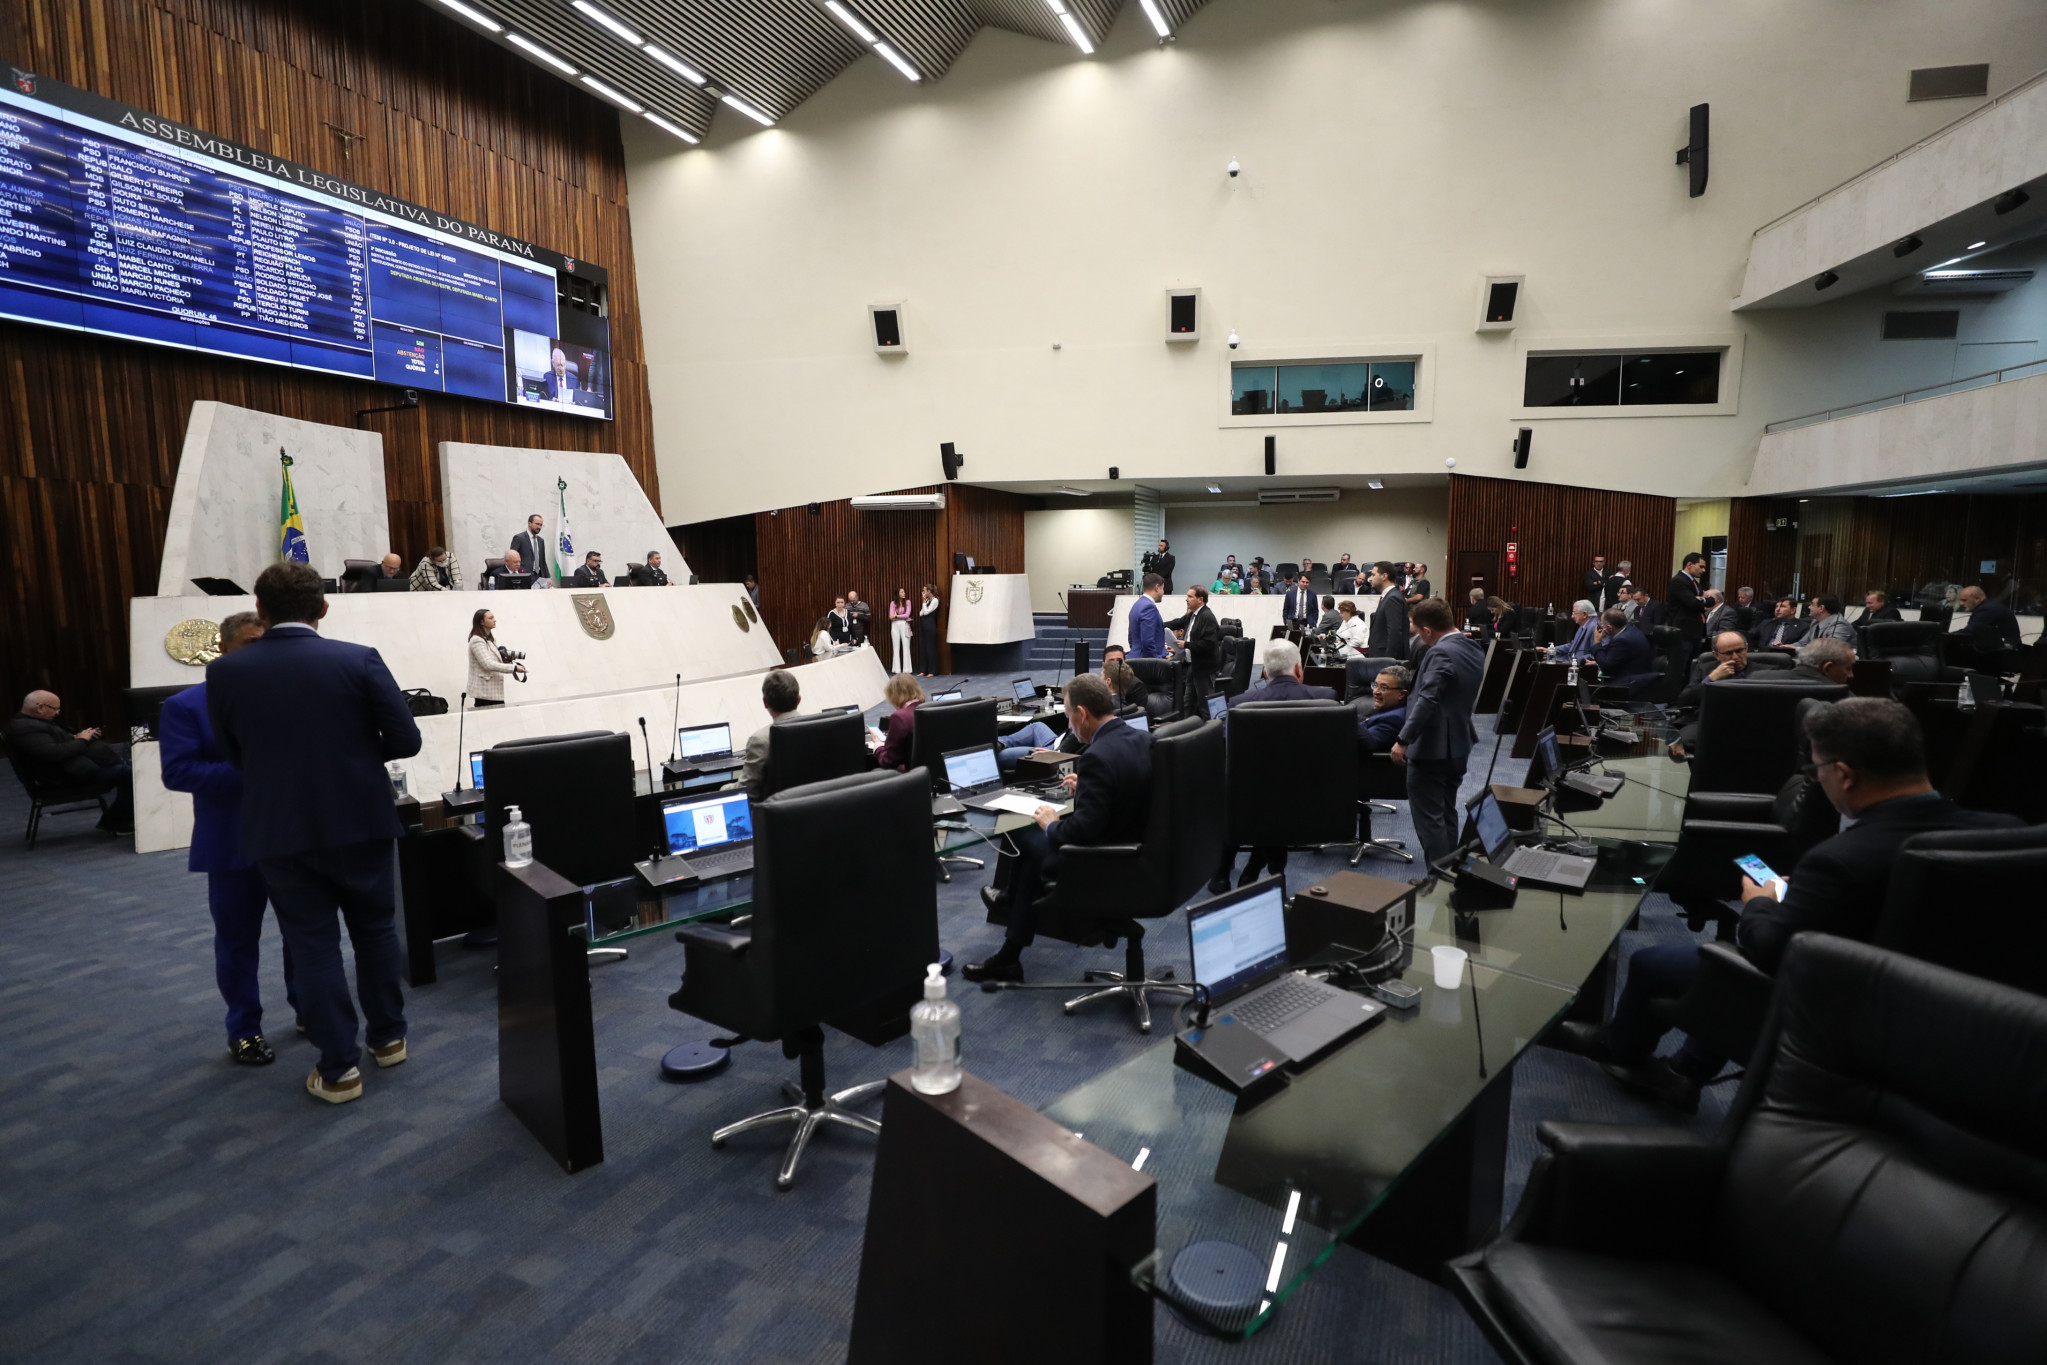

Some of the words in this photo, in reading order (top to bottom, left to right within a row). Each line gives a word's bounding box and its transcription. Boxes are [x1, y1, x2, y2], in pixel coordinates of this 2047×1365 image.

[82, 138, 100, 148] PSD
[83, 147, 101, 157] PSD
[78, 153, 108, 167] REPUB
[85, 164, 102, 173] PSD
[109, 155, 156, 174] FRANCISCO
[158, 169, 190, 184] BUHRER
[110, 163, 132, 174] GALO
[85, 172, 104, 183] MDB
[110, 172, 151, 187] GILBERTO
[153, 183, 184, 197] RIBEIRO
[120, 111, 292, 178] ASSEMBLEIA
[298, 168, 431, 224] LEGISLATIVA
[436, 216, 463, 234] DO
[468, 226, 534, 258] PARANÁ
[88, 189, 105, 199] PSD
[112, 180, 142, 194] GILSON
[144, 188, 155, 198] DE
[157, 193, 183, 205] SOUZA
[112, 188, 142, 201] GOURA
[229, 191, 243, 200] PSD
[88, 197, 106, 207] PSD
[114, 197, 136, 207] GUTO
[138, 203, 159, 214] SILVA
[250, 197, 278, 210] MICHELE
[280, 206, 306, 218] CAPUTO
[114, 205, 150, 219] HOMERO
[152, 214, 194, 231] MARCHESE
[250, 205, 276, 217] NELSON
[115, 213, 141, 225] JONAS
[232, 221, 245, 230] PDT
[251, 212, 277, 224] NELSON
[279, 220, 308, 233] LUERSEN
[91, 222, 108, 232] PSD
[115, 221, 149, 234] LUCIANA
[152, 230, 190, 244] RAFAGNIN
[252, 220, 274, 230] NEREU
[276, 226, 299, 237] MOURA
[252, 227, 273, 237] PAULO
[275, 234, 294, 242] LITRO
[26, 232, 66, 246] MARTINS
[90, 239, 113, 250] PSDB
[228, 235, 251, 246] REPUB
[253, 234, 278, 245] PLAUTO
[88, 246, 116, 258] REPUB
[117, 237, 135, 247] LUIZ
[137, 242, 171, 255] CLAUDIO
[173, 251, 215, 266] ROMANELLI
[253, 241, 292, 257] PROFESSOR
[294, 253, 316, 262] LEMOS
[118, 246, 135, 254] LUIZ
[138, 250, 180, 265] FERNANDO
[182, 261, 213, 273] GUERRA
[119, 254, 146, 265] MABEL
[147, 261, 174, 271] CANTO
[254, 256, 284, 268] REQUIÃO
[286, 264, 303, 273] FILHO
[95, 264, 113, 273] CDN
[120, 262, 152, 274] MARCEL
[154, 270, 202, 285] MICHELETTO
[235, 266, 249, 274] PSD
[255, 263, 284, 276] RICARDO
[286, 271, 312, 282] ARRUDA
[92, 271, 117, 282] UNIÃO
[121, 270, 152, 282] MARCIO
[154, 278, 180, 288] NUNES
[256, 271, 286, 283] RODRIGO
[288, 278, 316, 290] ESTACHO
[93, 280, 118, 291] UNIÃO
[121, 278, 152, 290] MARCIO
[154, 285, 190, 298] PACHECO
[256, 278, 287, 290] SOLDADO
[288, 286, 316, 297] ADRIANO
[122, 286, 147, 297] MARIA
[148, 292, 184, 304] VICTÓRIA
[238, 295, 251, 304] PSD
[257, 286, 288, 298] SOLDADO
[290, 292, 309, 302] FRUET
[257, 292, 278, 302] TADEU
[280, 298, 303, 308] VENERI
[234, 302, 256, 312] REPUB
[258, 307, 277, 316] TIAGO
[279, 312, 305, 322] AMARAL
[259, 314, 274, 323] TIÃO
[275, 319, 308, 330] MEDEIROS
